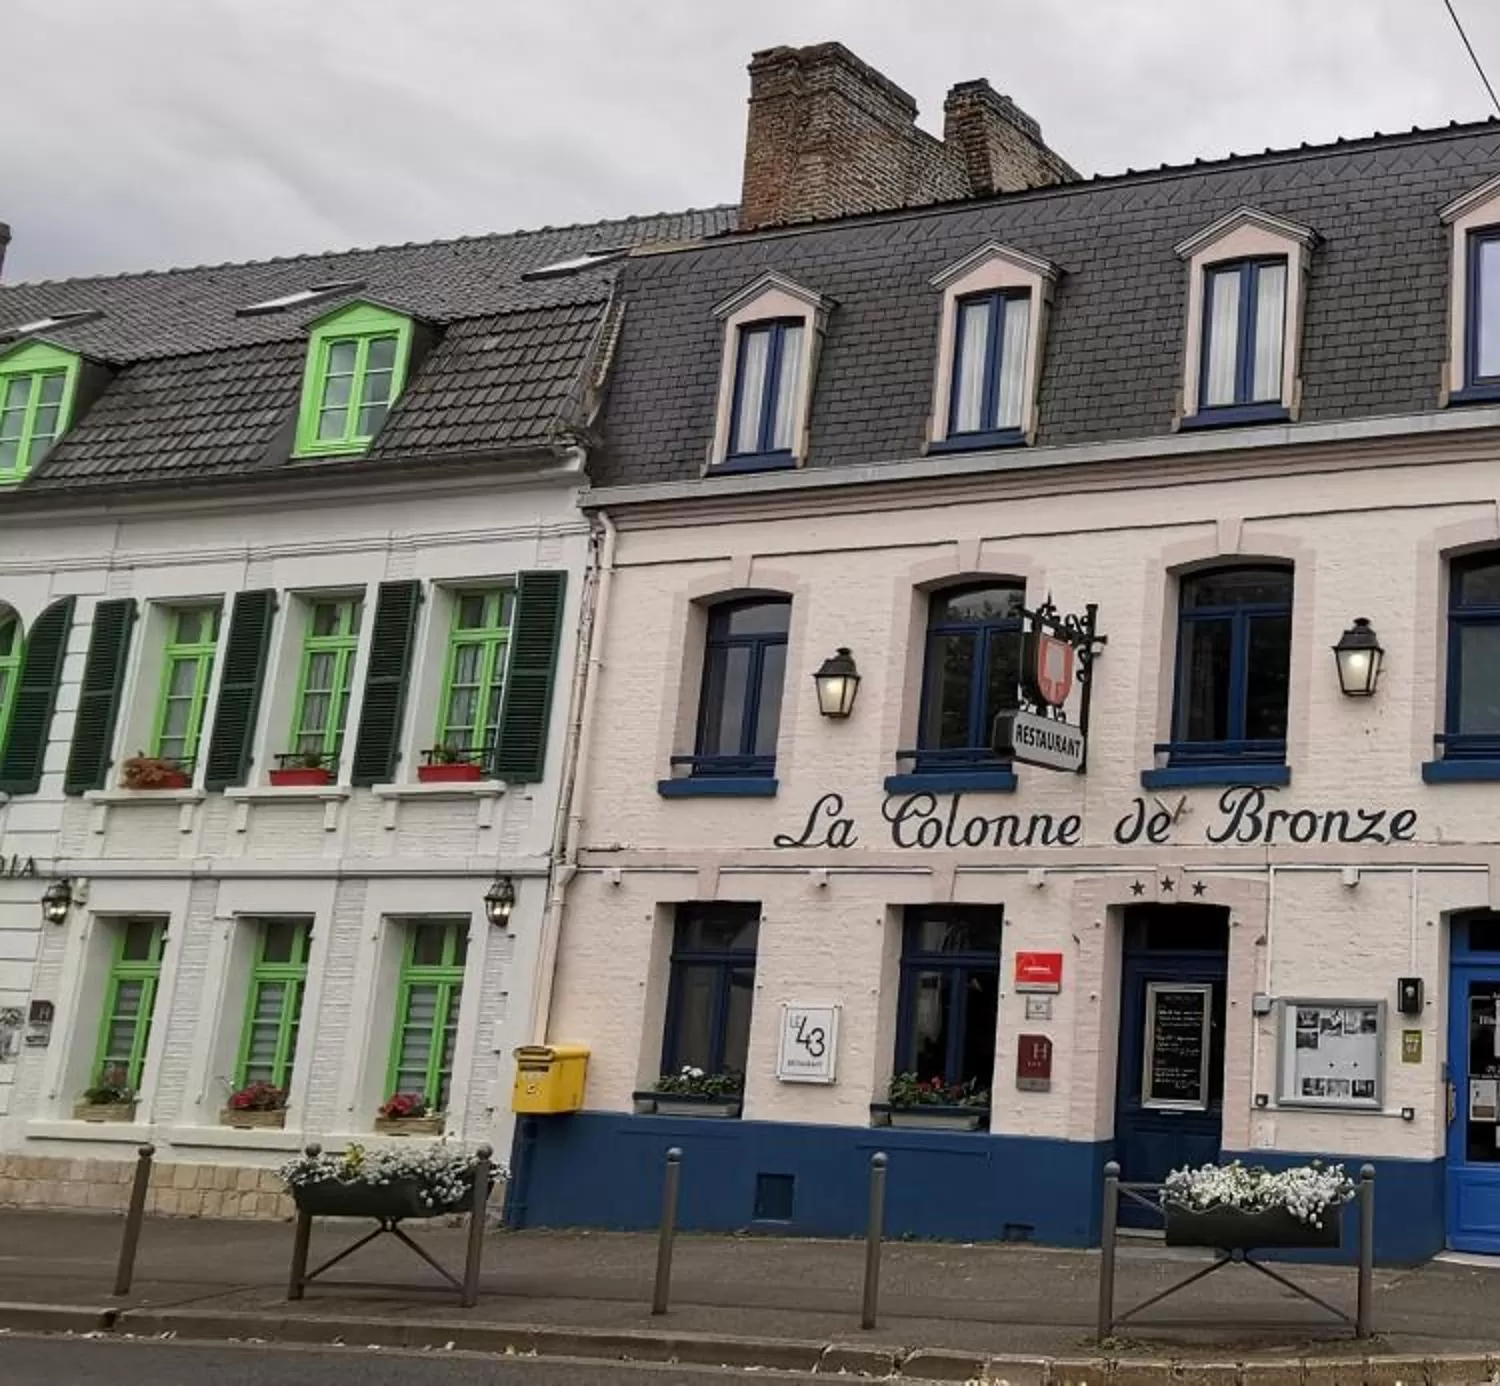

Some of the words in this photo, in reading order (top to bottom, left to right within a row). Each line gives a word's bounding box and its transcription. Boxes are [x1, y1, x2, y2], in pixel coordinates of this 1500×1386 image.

[1015, 723, 1082, 758] RESTAURANT
[774, 794, 858, 849] La
[882, 792, 1082, 848] Colonne
[1115, 797, 1172, 845] de
[1206, 786, 1417, 844] Bronze
[796, 1015, 825, 1058] 43
